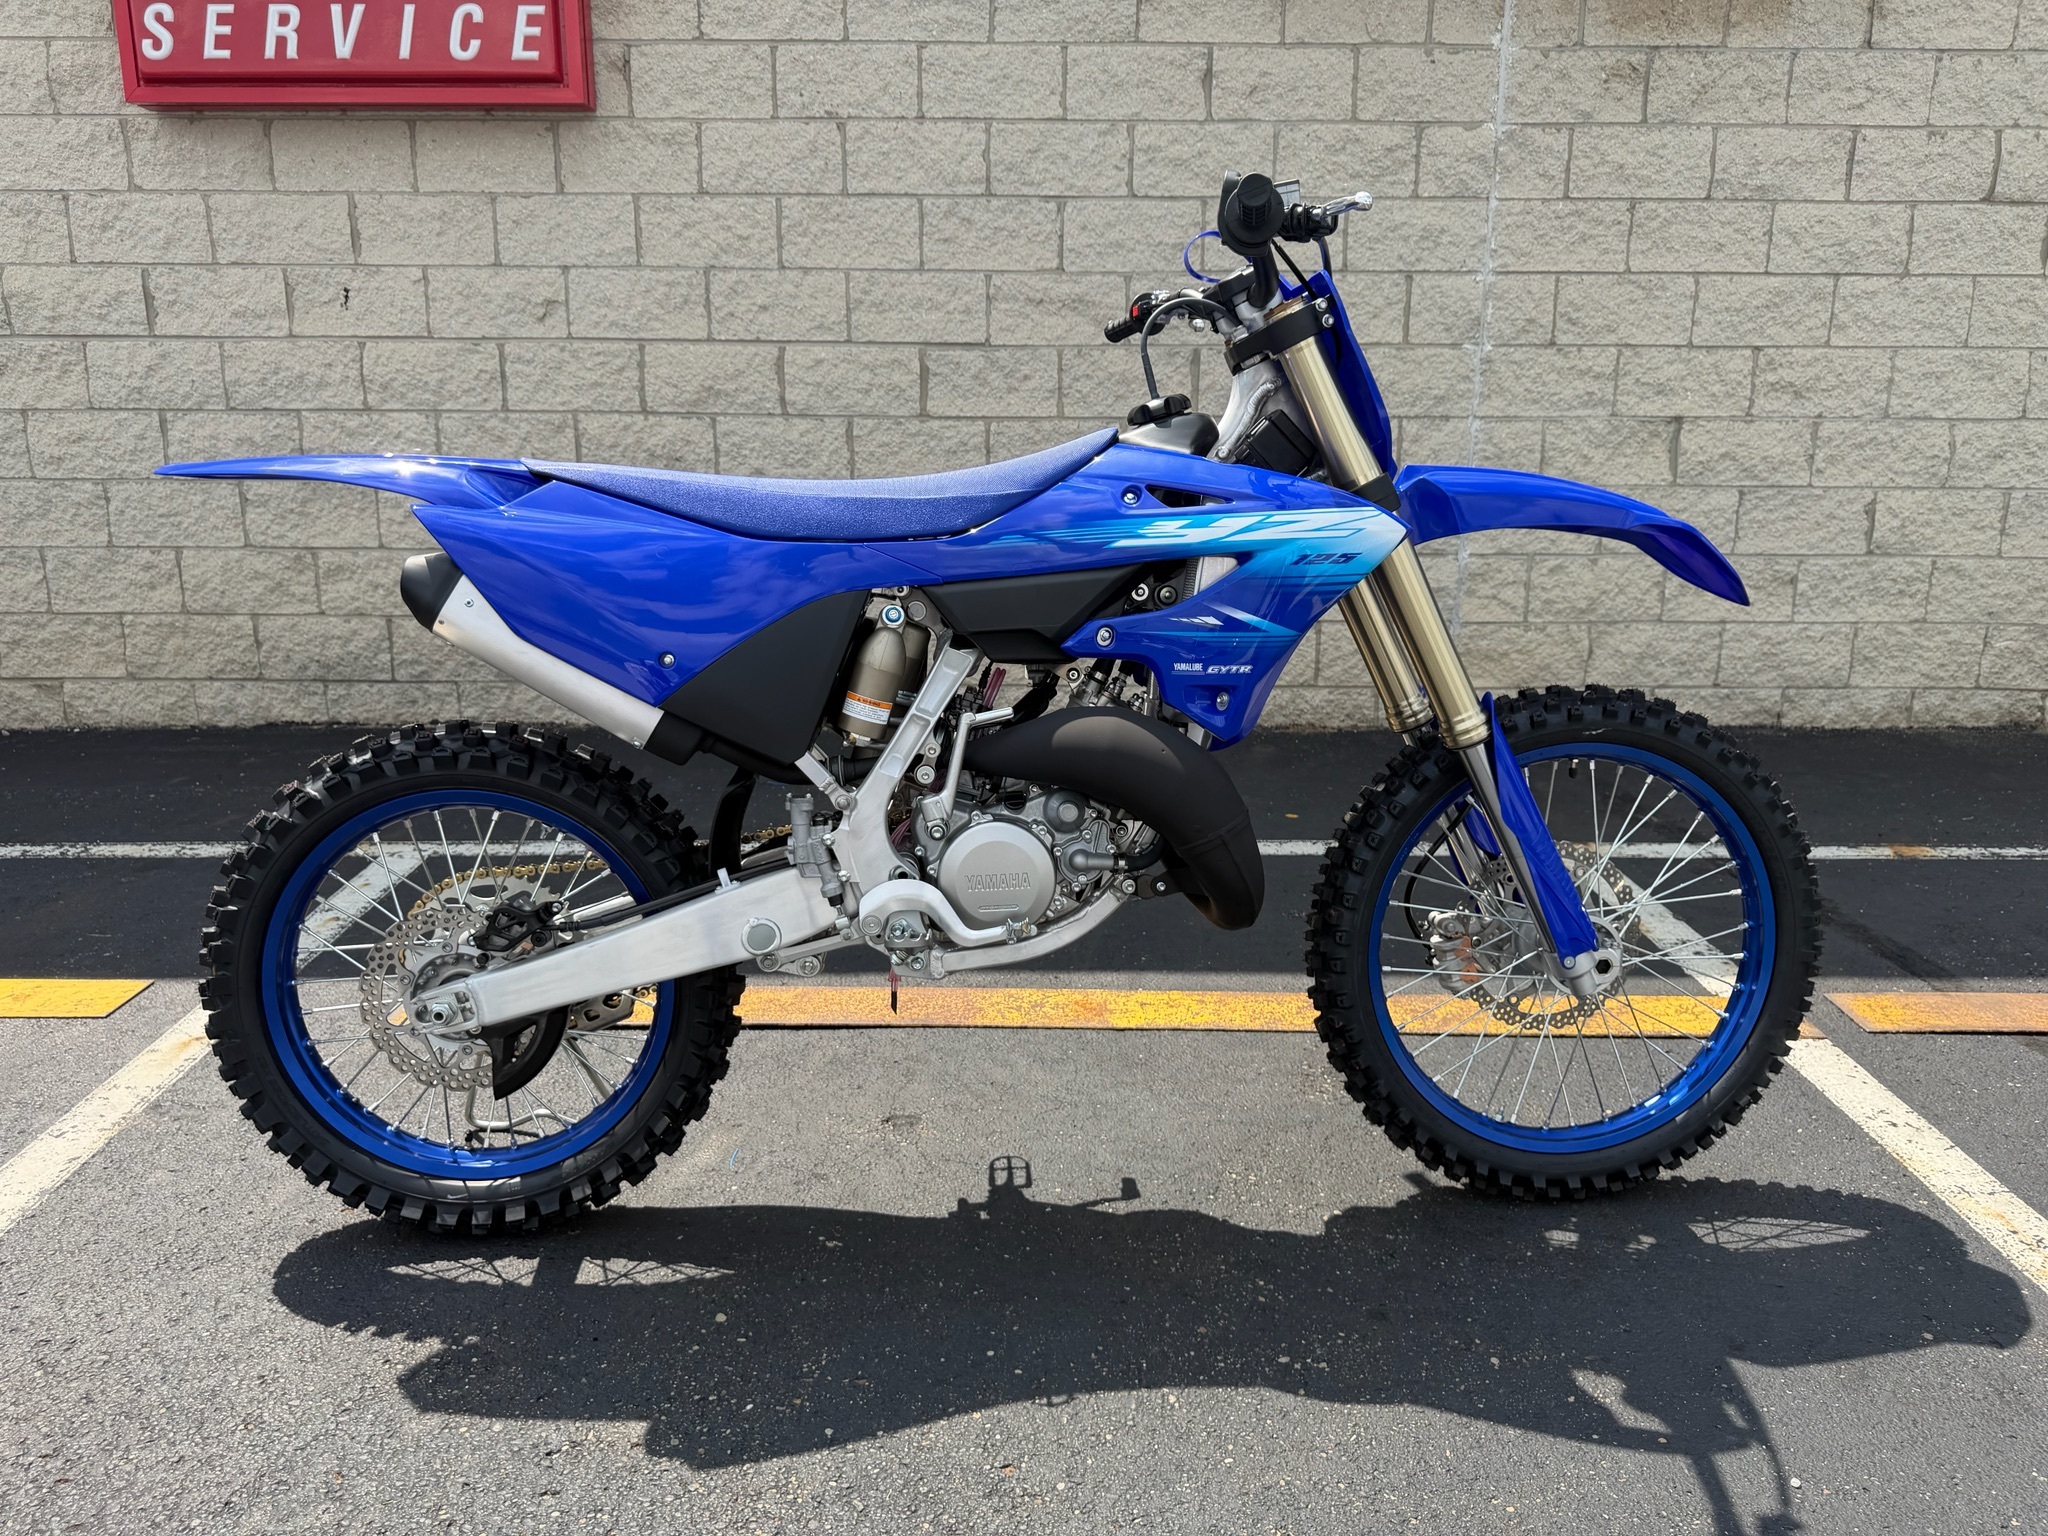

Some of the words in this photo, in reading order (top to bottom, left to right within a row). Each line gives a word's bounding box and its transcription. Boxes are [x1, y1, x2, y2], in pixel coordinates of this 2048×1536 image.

[141, 2, 546, 61] SERVICE
[1104, 507, 1382, 549] YZ
[1290, 552, 1363, 566] 125
[1173, 662, 1204, 671] YAMALUBE
[1205, 664, 1254, 675] GYTR
[964, 872, 1032, 893] YAMAHA
